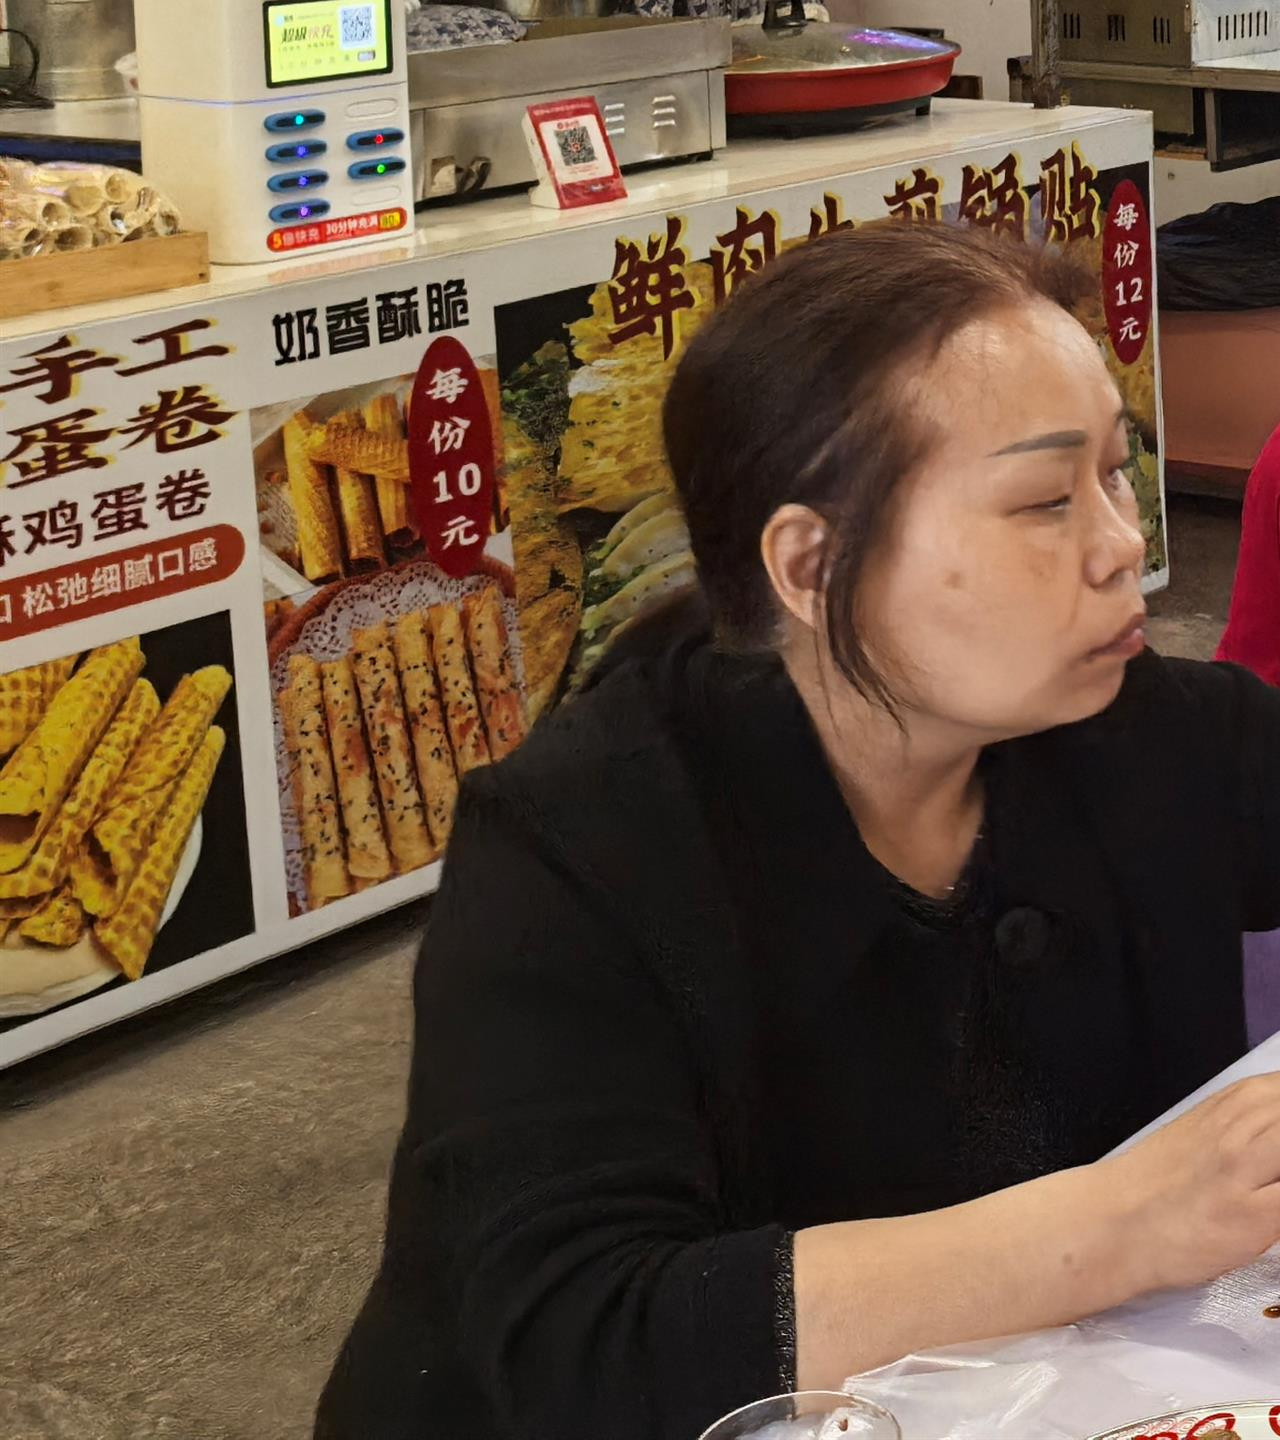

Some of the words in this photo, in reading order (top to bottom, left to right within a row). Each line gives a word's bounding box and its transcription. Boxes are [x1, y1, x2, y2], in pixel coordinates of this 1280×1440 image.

[1113, 202, 1143, 343] 每份12元
[0, 318, 231, 405] 手工
[272, 278, 470, 367] 奶香酥脆
[2, 385, 239, 490] 蛋卷
[425, 368, 483, 552] 每份10元
[22, 537, 219, 620] 松弛细腻口感
